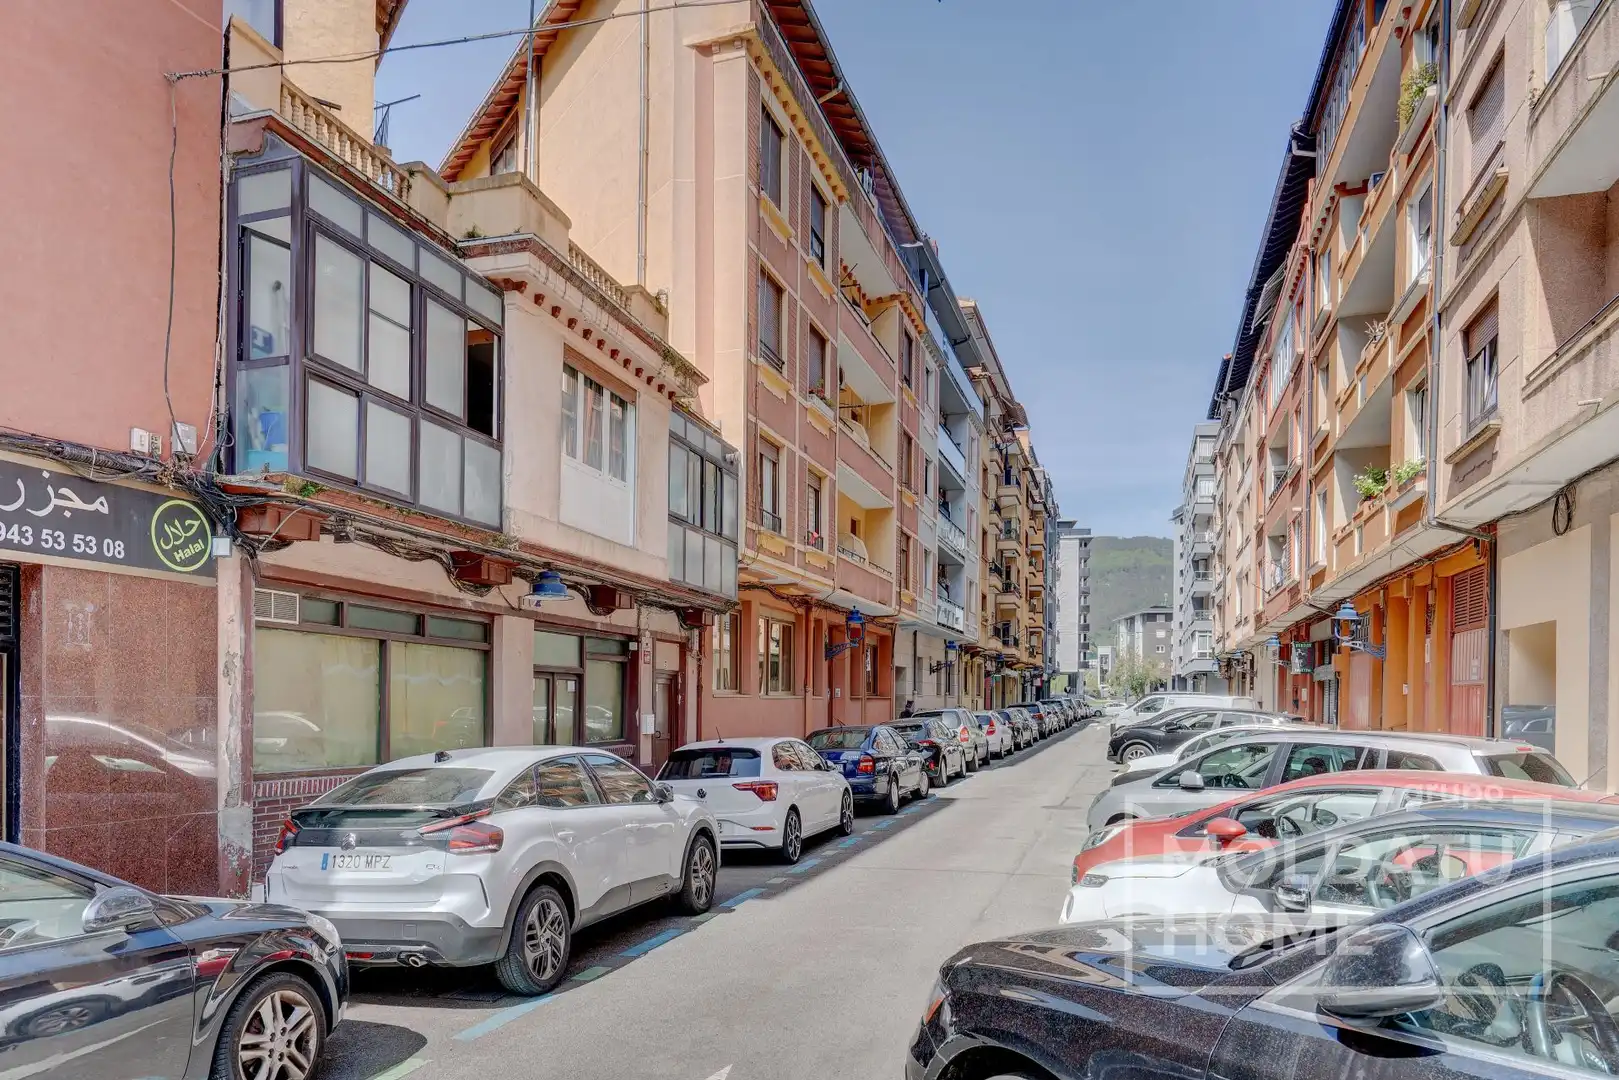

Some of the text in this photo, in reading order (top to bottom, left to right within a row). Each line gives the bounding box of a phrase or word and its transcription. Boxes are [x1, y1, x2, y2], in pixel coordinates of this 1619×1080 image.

[0, 471, 109, 517] مجزر
[41, 528, 65, 550] 53
[72, 533, 97, 554] 53
[103, 538, 125, 559] 08
[160, 518, 201, 549] حلال
[173, 538, 205, 562] Halal
[332, 854, 391, 869] 1320 MPZ
